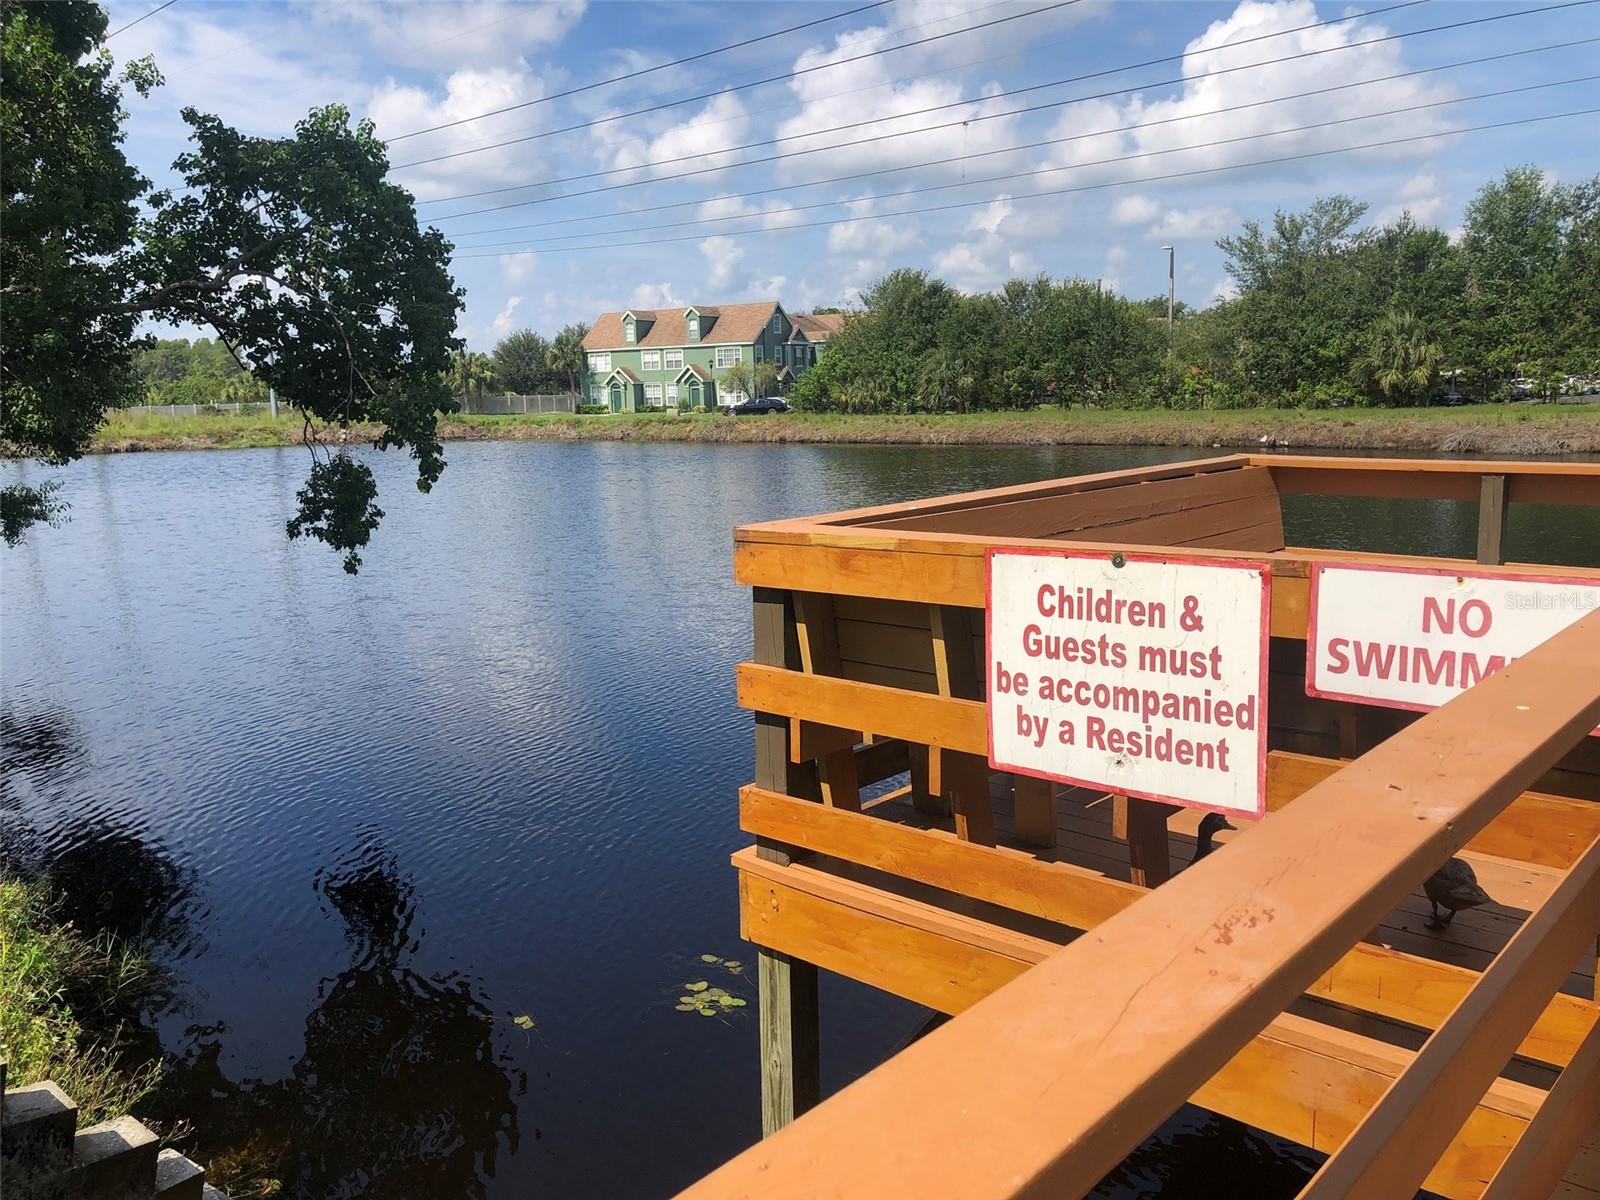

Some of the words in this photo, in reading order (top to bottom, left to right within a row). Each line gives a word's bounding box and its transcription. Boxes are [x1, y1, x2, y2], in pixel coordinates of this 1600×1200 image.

[1037, 584, 1166, 628] Children
[1180, 595, 1204, 633] &
[1422, 597, 1492, 638] NO
[1022, 624, 1127, 668] Guests
[1139, 645, 1222, 681] must
[1326, 638, 1519, 689] SWIMM
[996, 661, 1029, 696] be
[1038, 674, 1255, 731] accompanied
[1016, 704, 1048, 748] by
[1058, 719, 1075, 745] a
[1086, 716, 1230, 773] Resident
